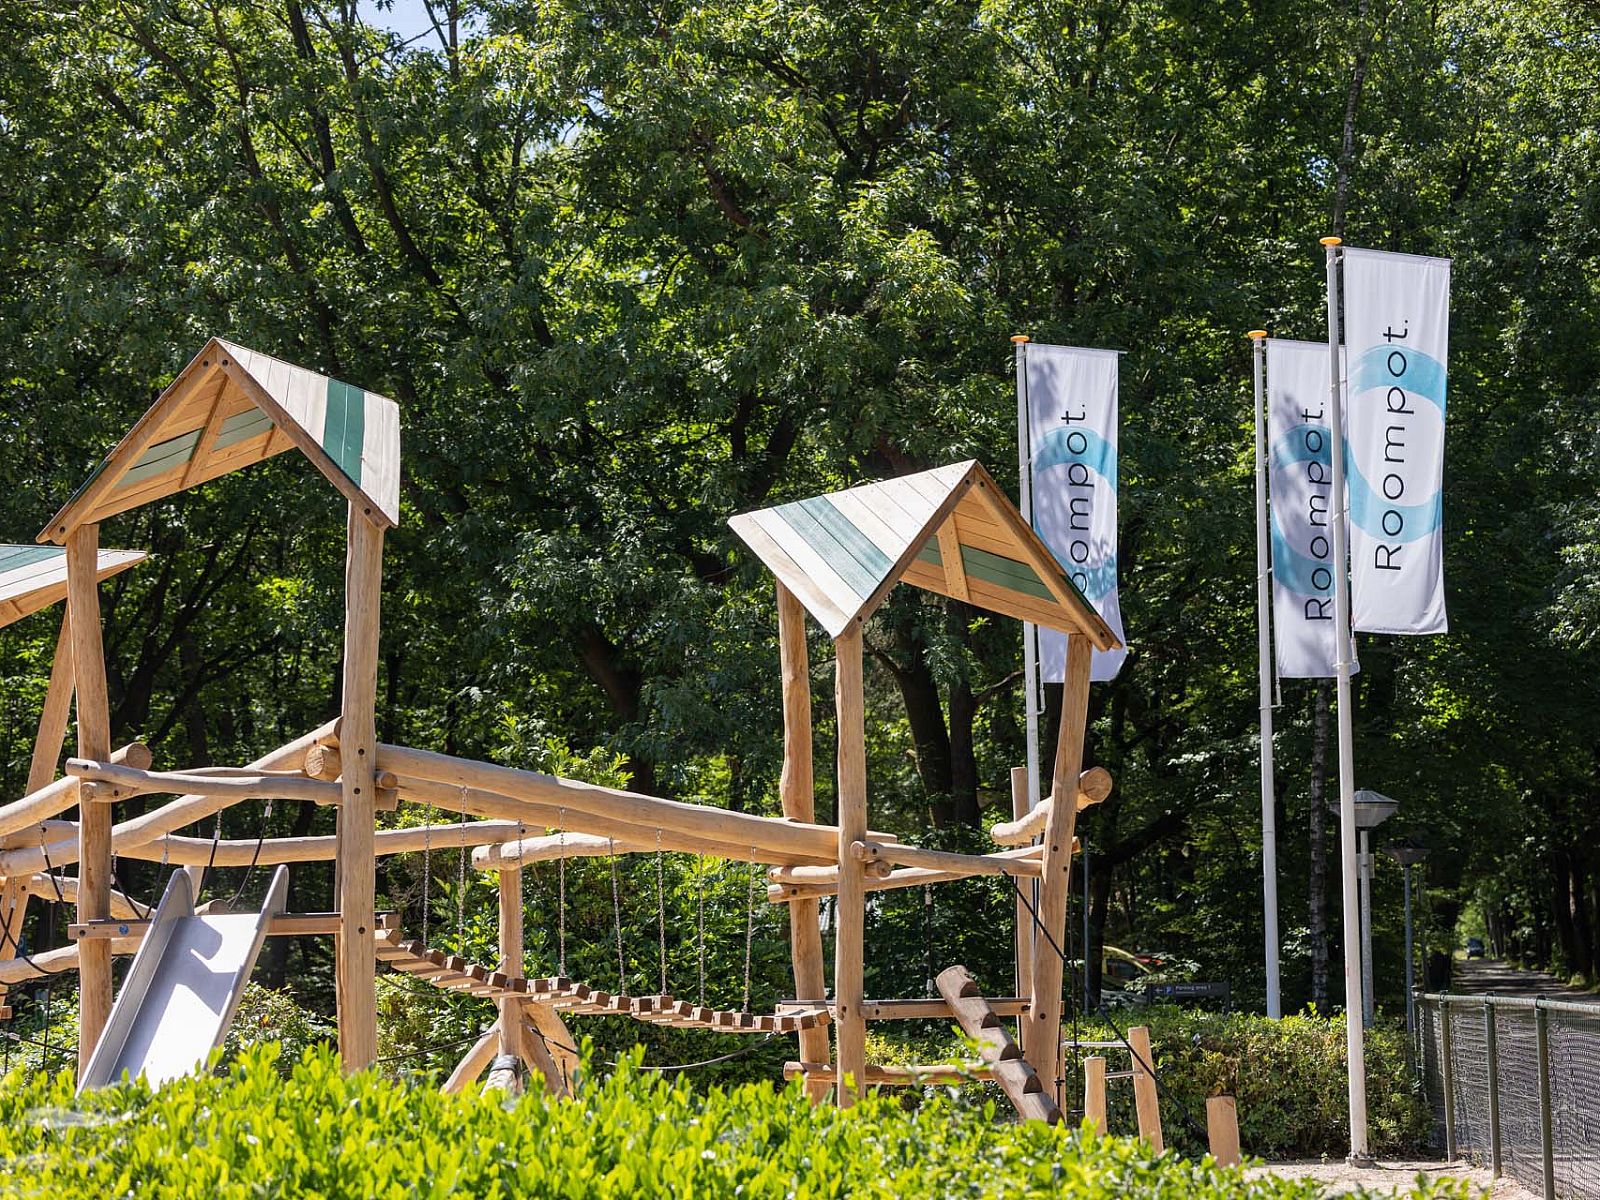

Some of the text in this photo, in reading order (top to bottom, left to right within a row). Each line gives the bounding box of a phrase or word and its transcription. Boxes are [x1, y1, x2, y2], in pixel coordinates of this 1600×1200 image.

[1061, 403, 1095, 594] oompot.
[1302, 401, 1333, 621] Roompot.
[1374, 319, 1415, 571] Roompot.
